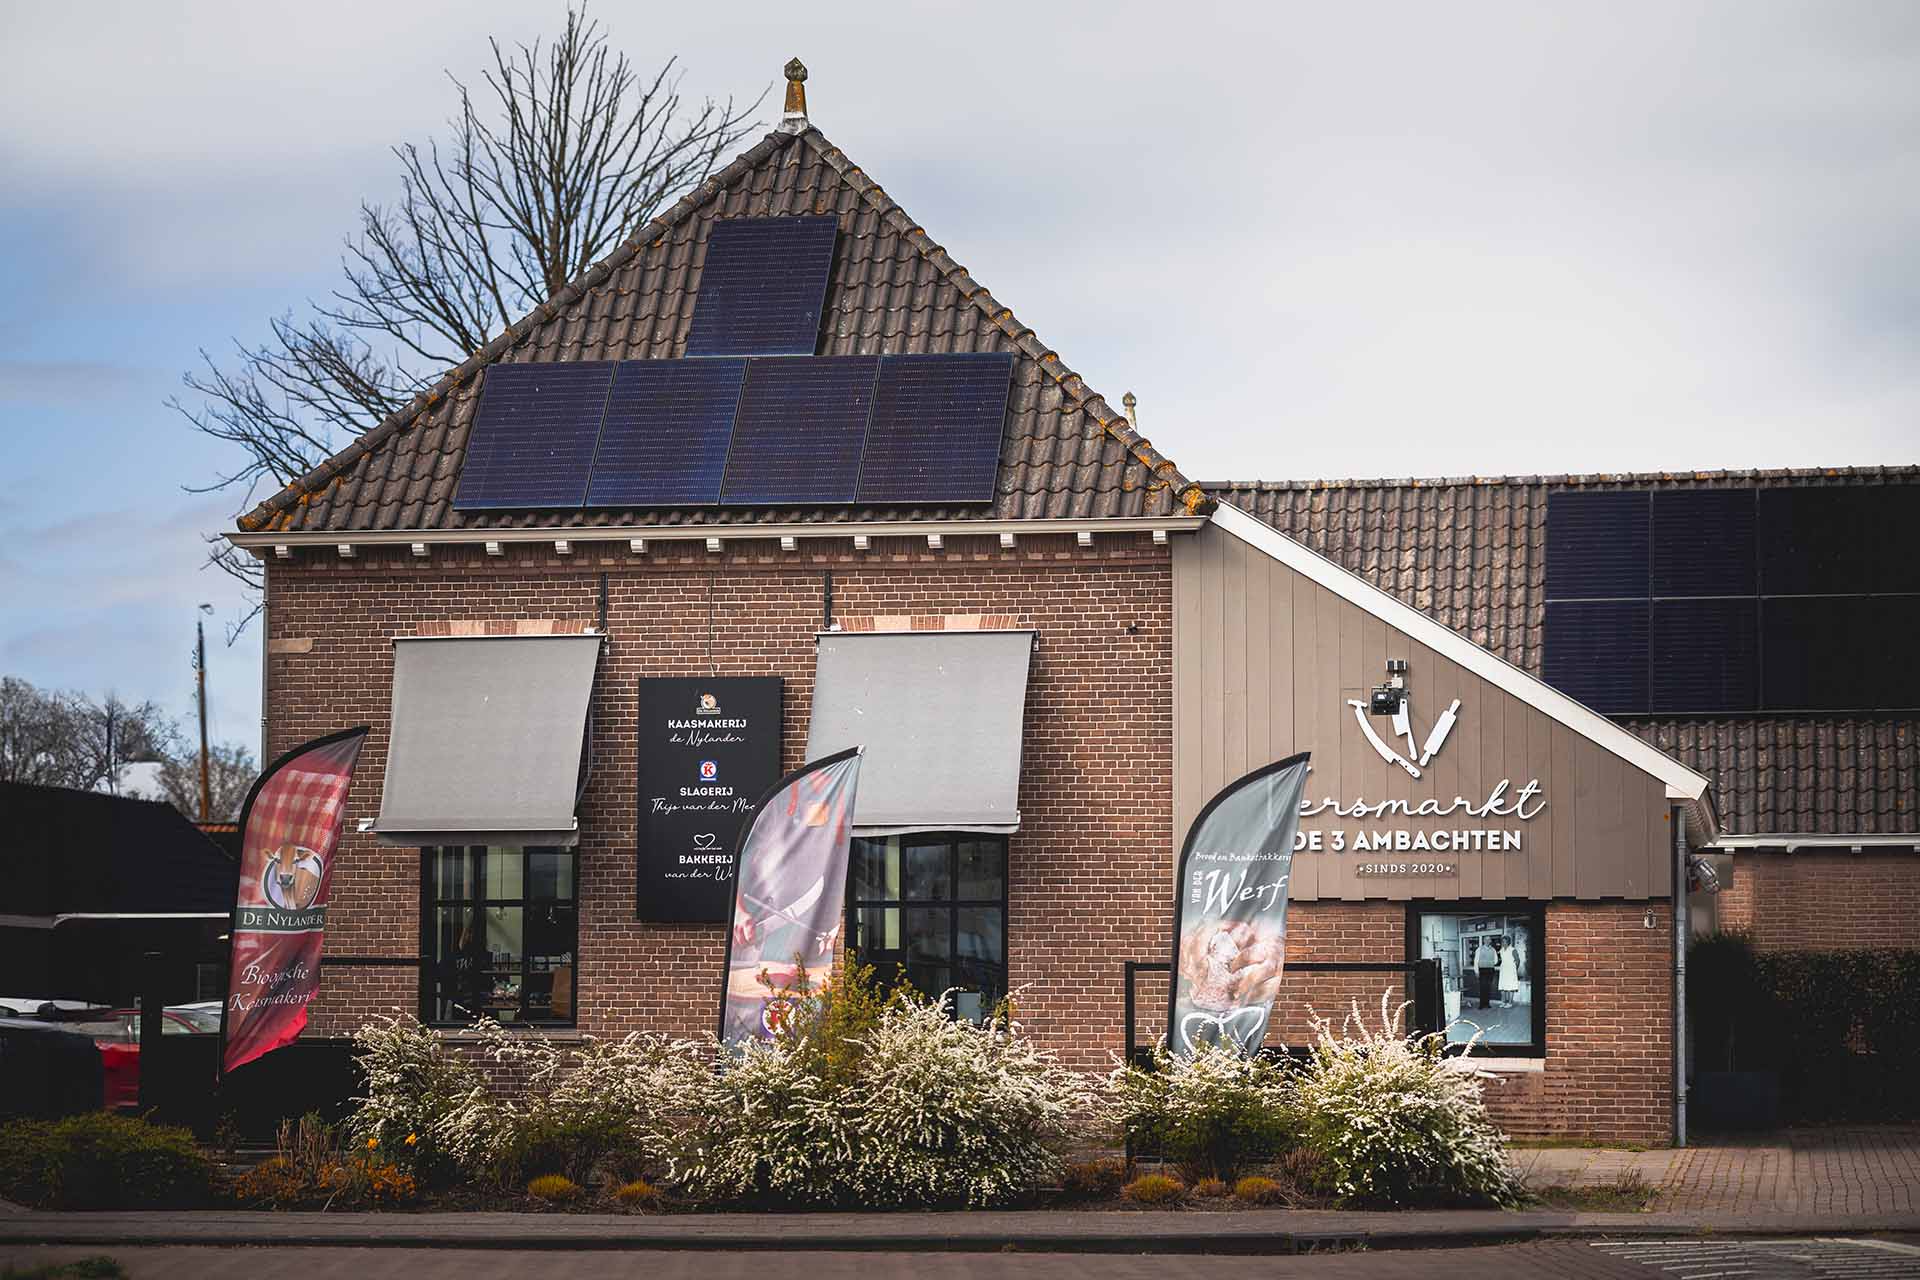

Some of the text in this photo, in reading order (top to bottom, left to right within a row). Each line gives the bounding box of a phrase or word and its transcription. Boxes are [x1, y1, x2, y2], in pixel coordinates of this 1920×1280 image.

[668, 719, 747, 729] KAASMAKERIJ
[669, 729, 744, 747] de Nylander
[680, 787, 734, 796] SLAGERIJ
[1299, 778, 1547, 820] ersmarkt
[651, 797, 681, 815] Thijs
[707, 800, 729, 811] der
[732, 797, 756, 814] Mee
[1294, 830, 1522, 851] DE 3 AMBACHTEN
[679, 855, 734, 864] BAKKERIJ
[665, 865, 733, 881] van der We
[1366, 864, 1444, 873] SINDS 2020
[1202, 868, 1289, 917] Werf
